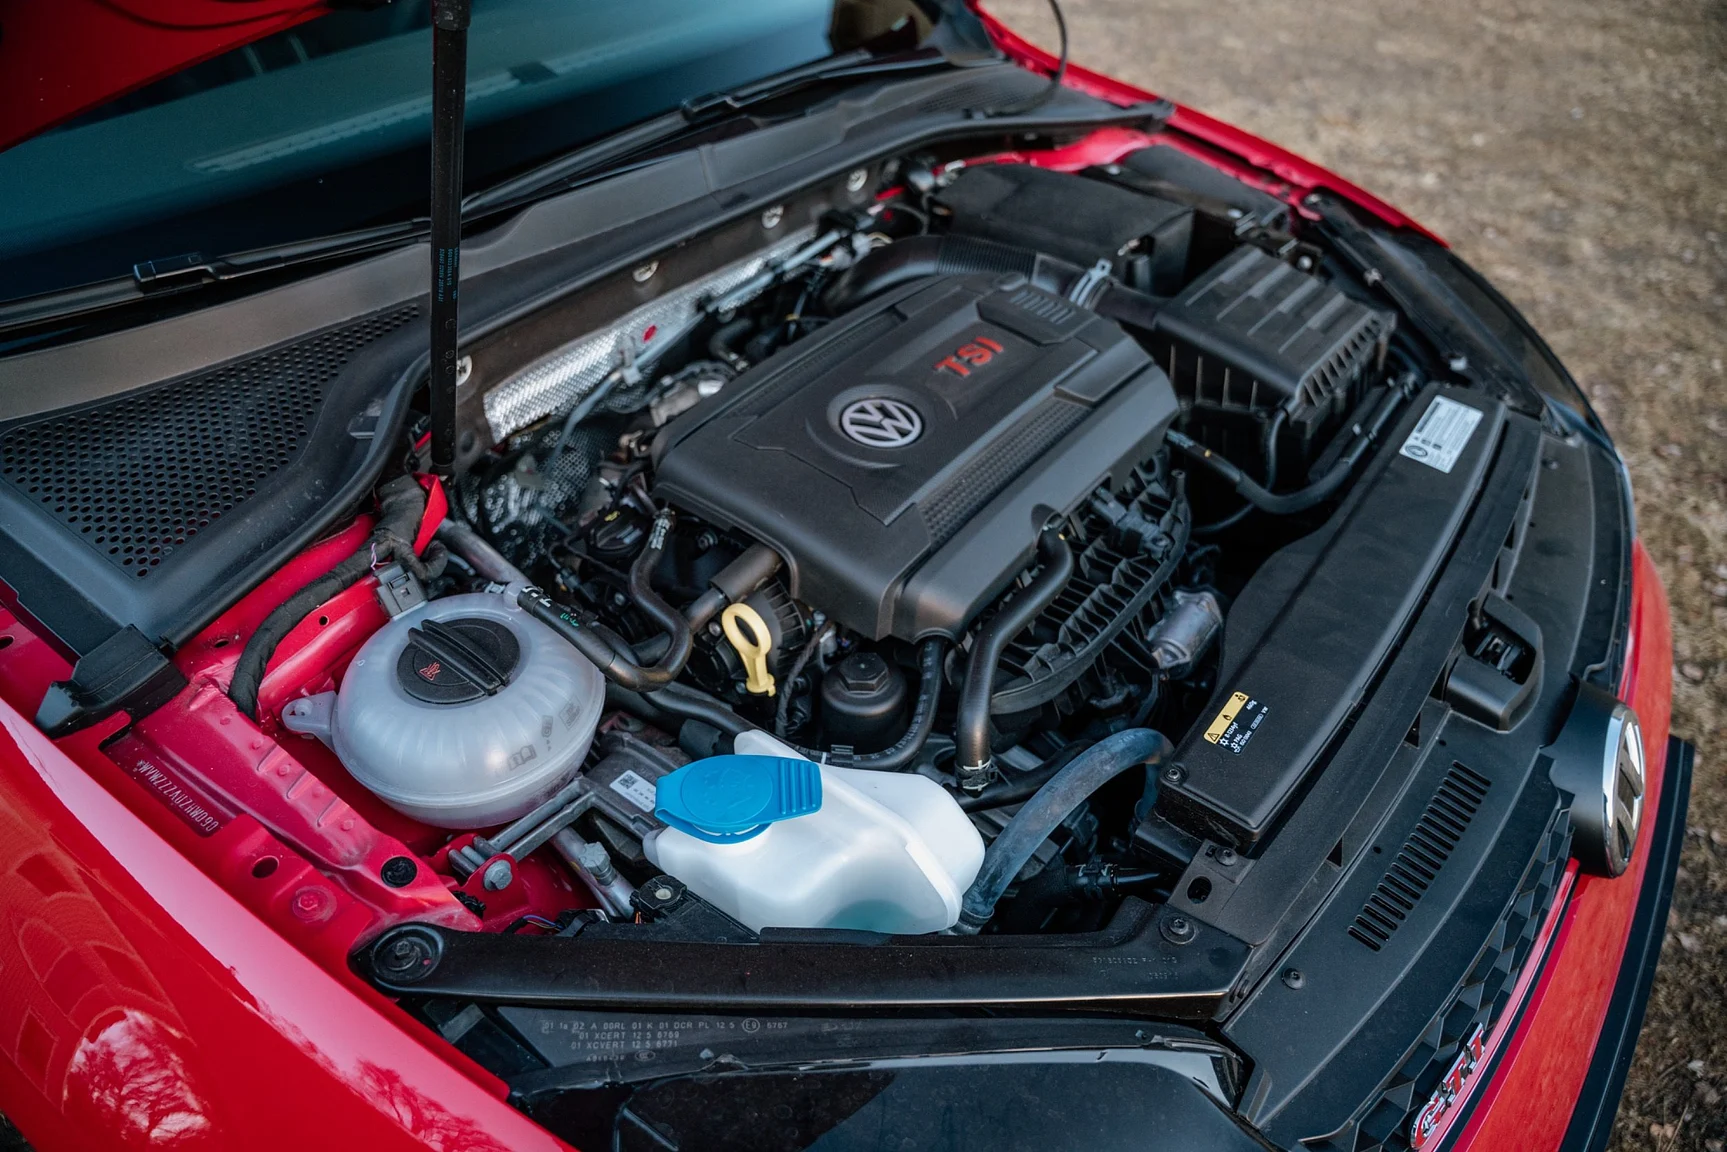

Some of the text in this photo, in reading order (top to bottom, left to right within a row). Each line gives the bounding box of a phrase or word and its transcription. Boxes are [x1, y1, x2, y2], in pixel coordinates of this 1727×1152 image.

[933, 336, 1004, 377] TSI
[841, 398, 923, 448] VW
[590, 1022, 598, 1030] A
[631, 1021, 642, 1030] 01
[646, 1021, 653, 1030] K
[698, 1021, 710, 1029] PL
[716, 1021, 726, 1029] 12
[594, 1031, 626, 1040] XCERT
[632, 1031, 642, 1039] 12
[646, 1031, 652, 1039] 5
[631, 1040, 641, 1049] 12
[644, 1040, 651, 1049] 5
[1411, 1022, 1485, 1149] GTI
